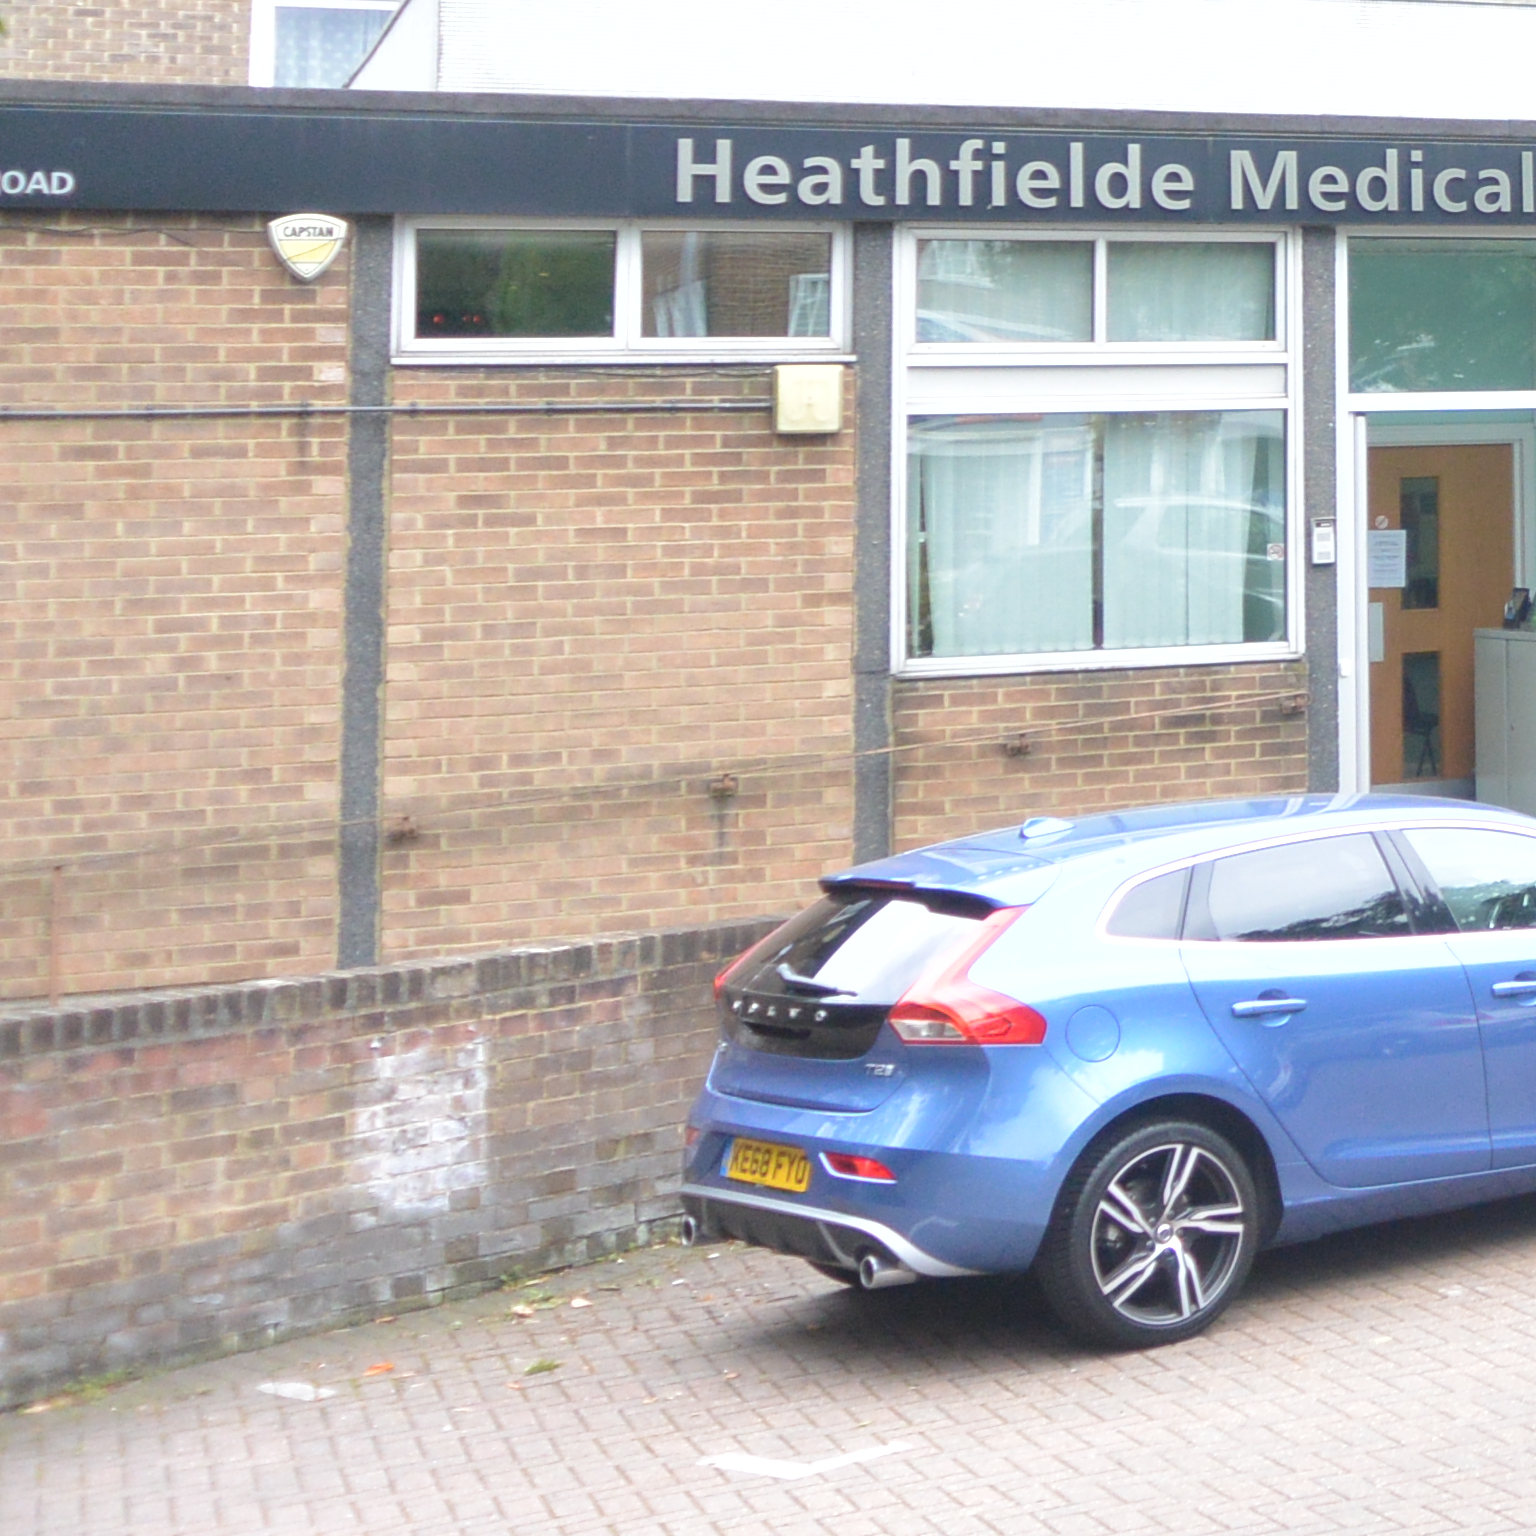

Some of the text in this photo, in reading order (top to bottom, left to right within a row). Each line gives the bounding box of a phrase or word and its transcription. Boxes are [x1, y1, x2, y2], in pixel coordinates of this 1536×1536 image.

[0, 170, 76, 194] OAD
[676, 138, 1195, 211] Heathfielde
[1229, 148, 1534, 214] Medical
[283, 226, 334, 238] CAPSTAN
